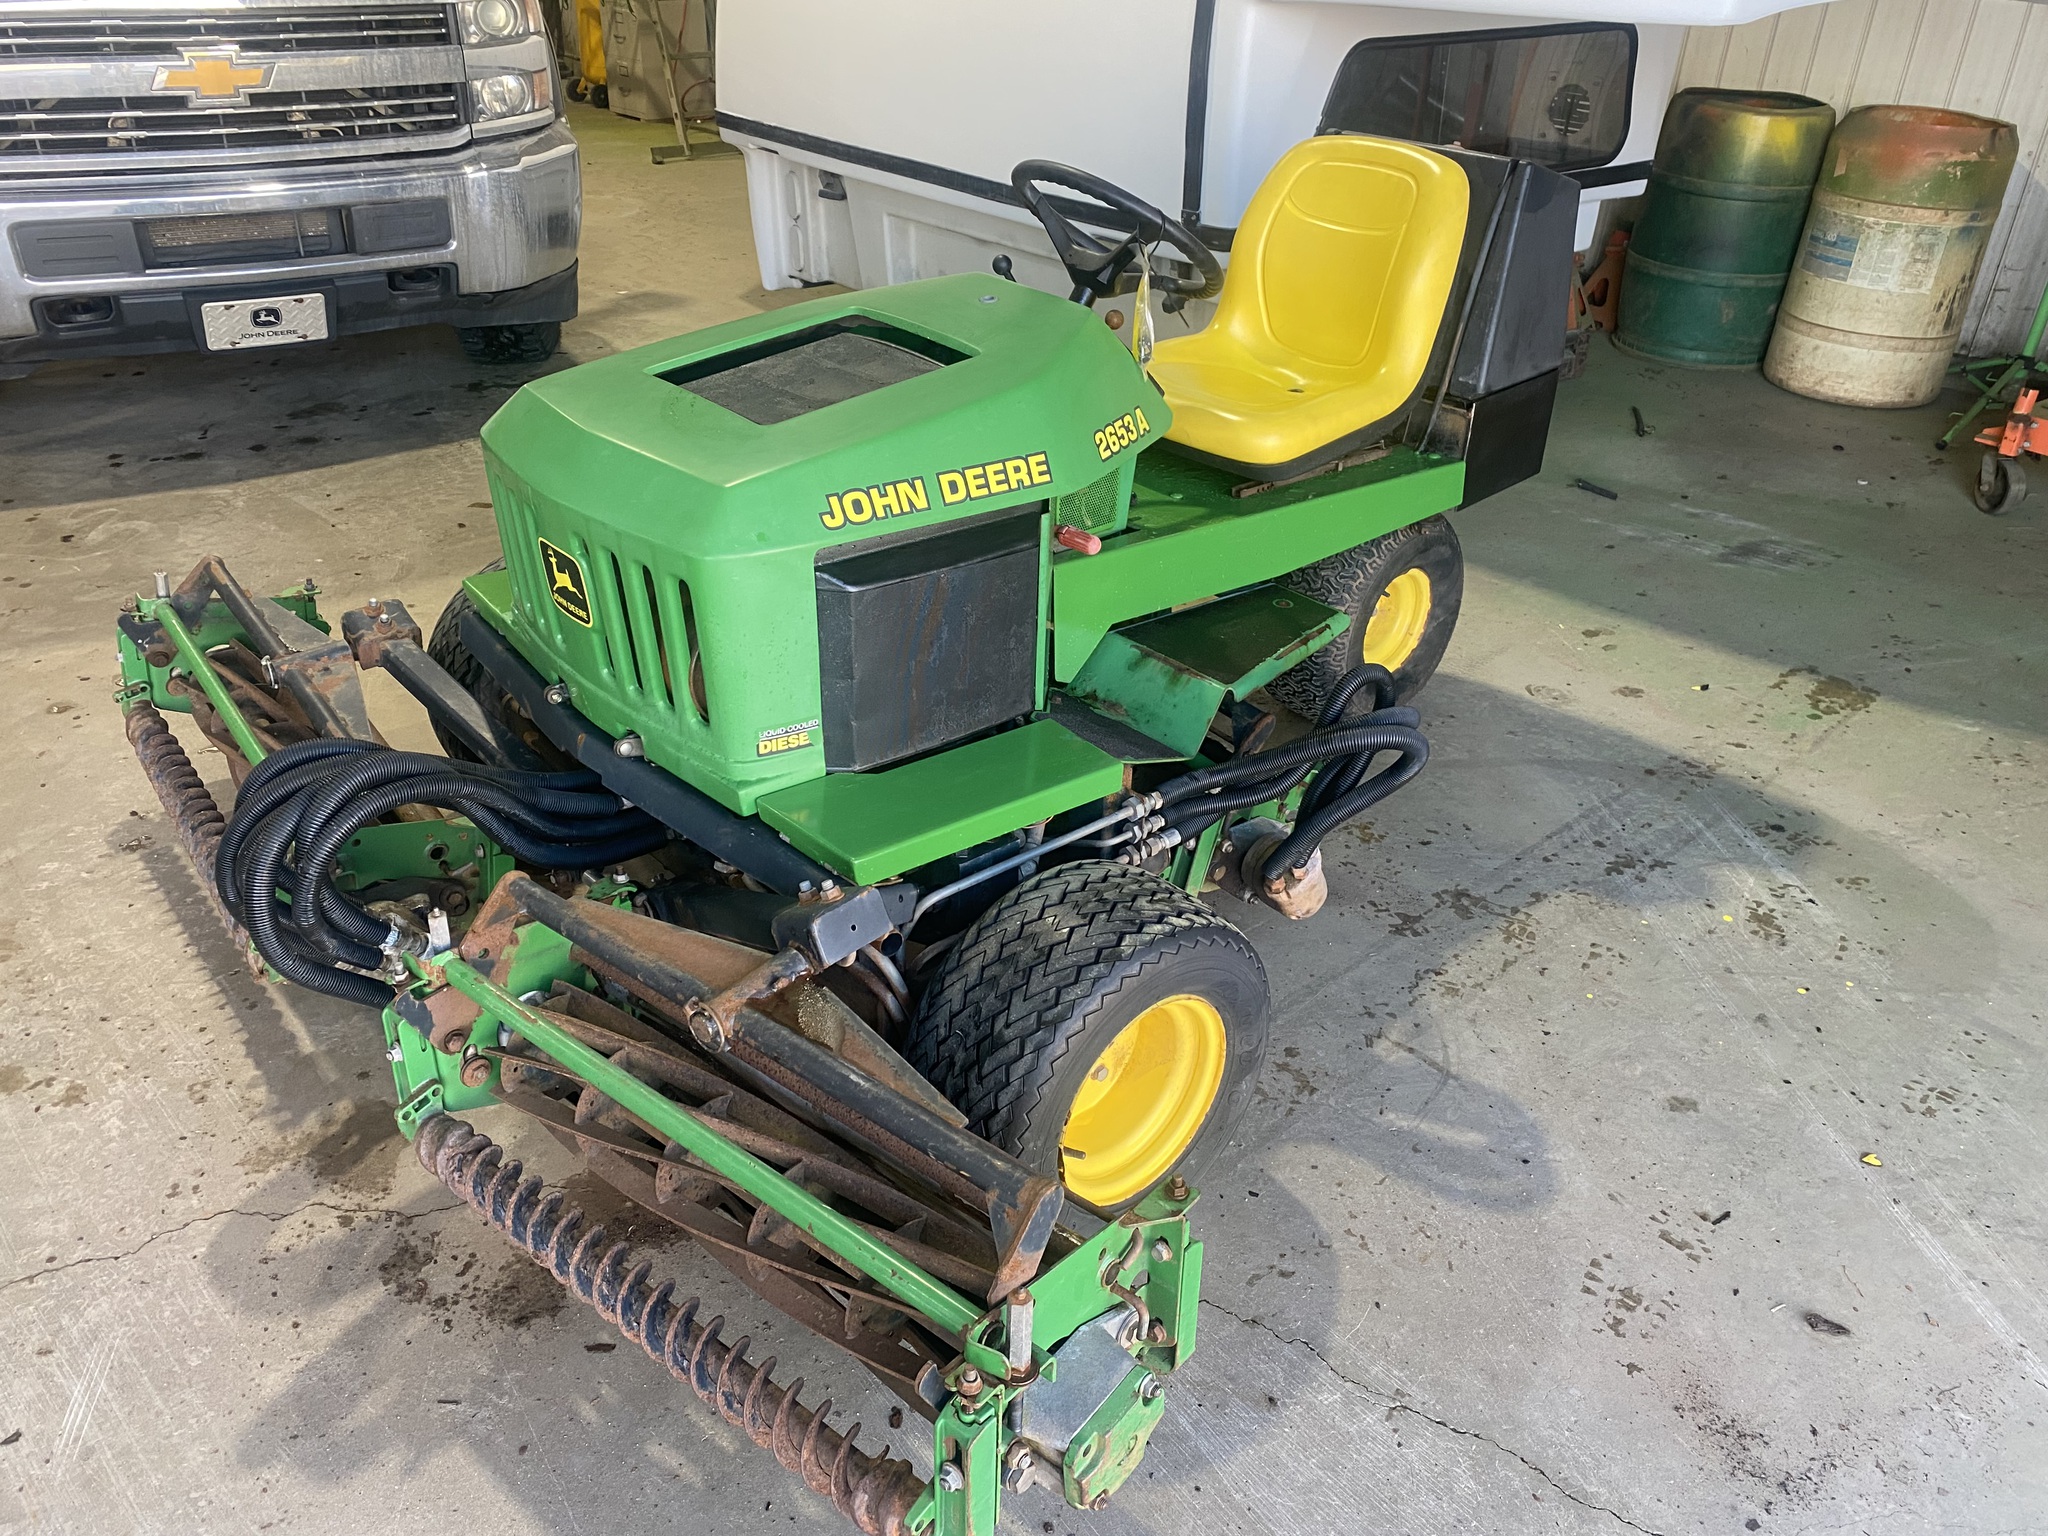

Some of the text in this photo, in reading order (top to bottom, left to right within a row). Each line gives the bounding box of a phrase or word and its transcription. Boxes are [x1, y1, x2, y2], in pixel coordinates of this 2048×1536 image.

[239, 329, 299, 340] JOHN DEERE
[819, 451, 1053, 531] JOHN DEERE
[553, 591, 588, 620] JOHN DEERE
[759, 719, 819, 739] LIQUID COOLED
[758, 731, 811, 755] DIESE
